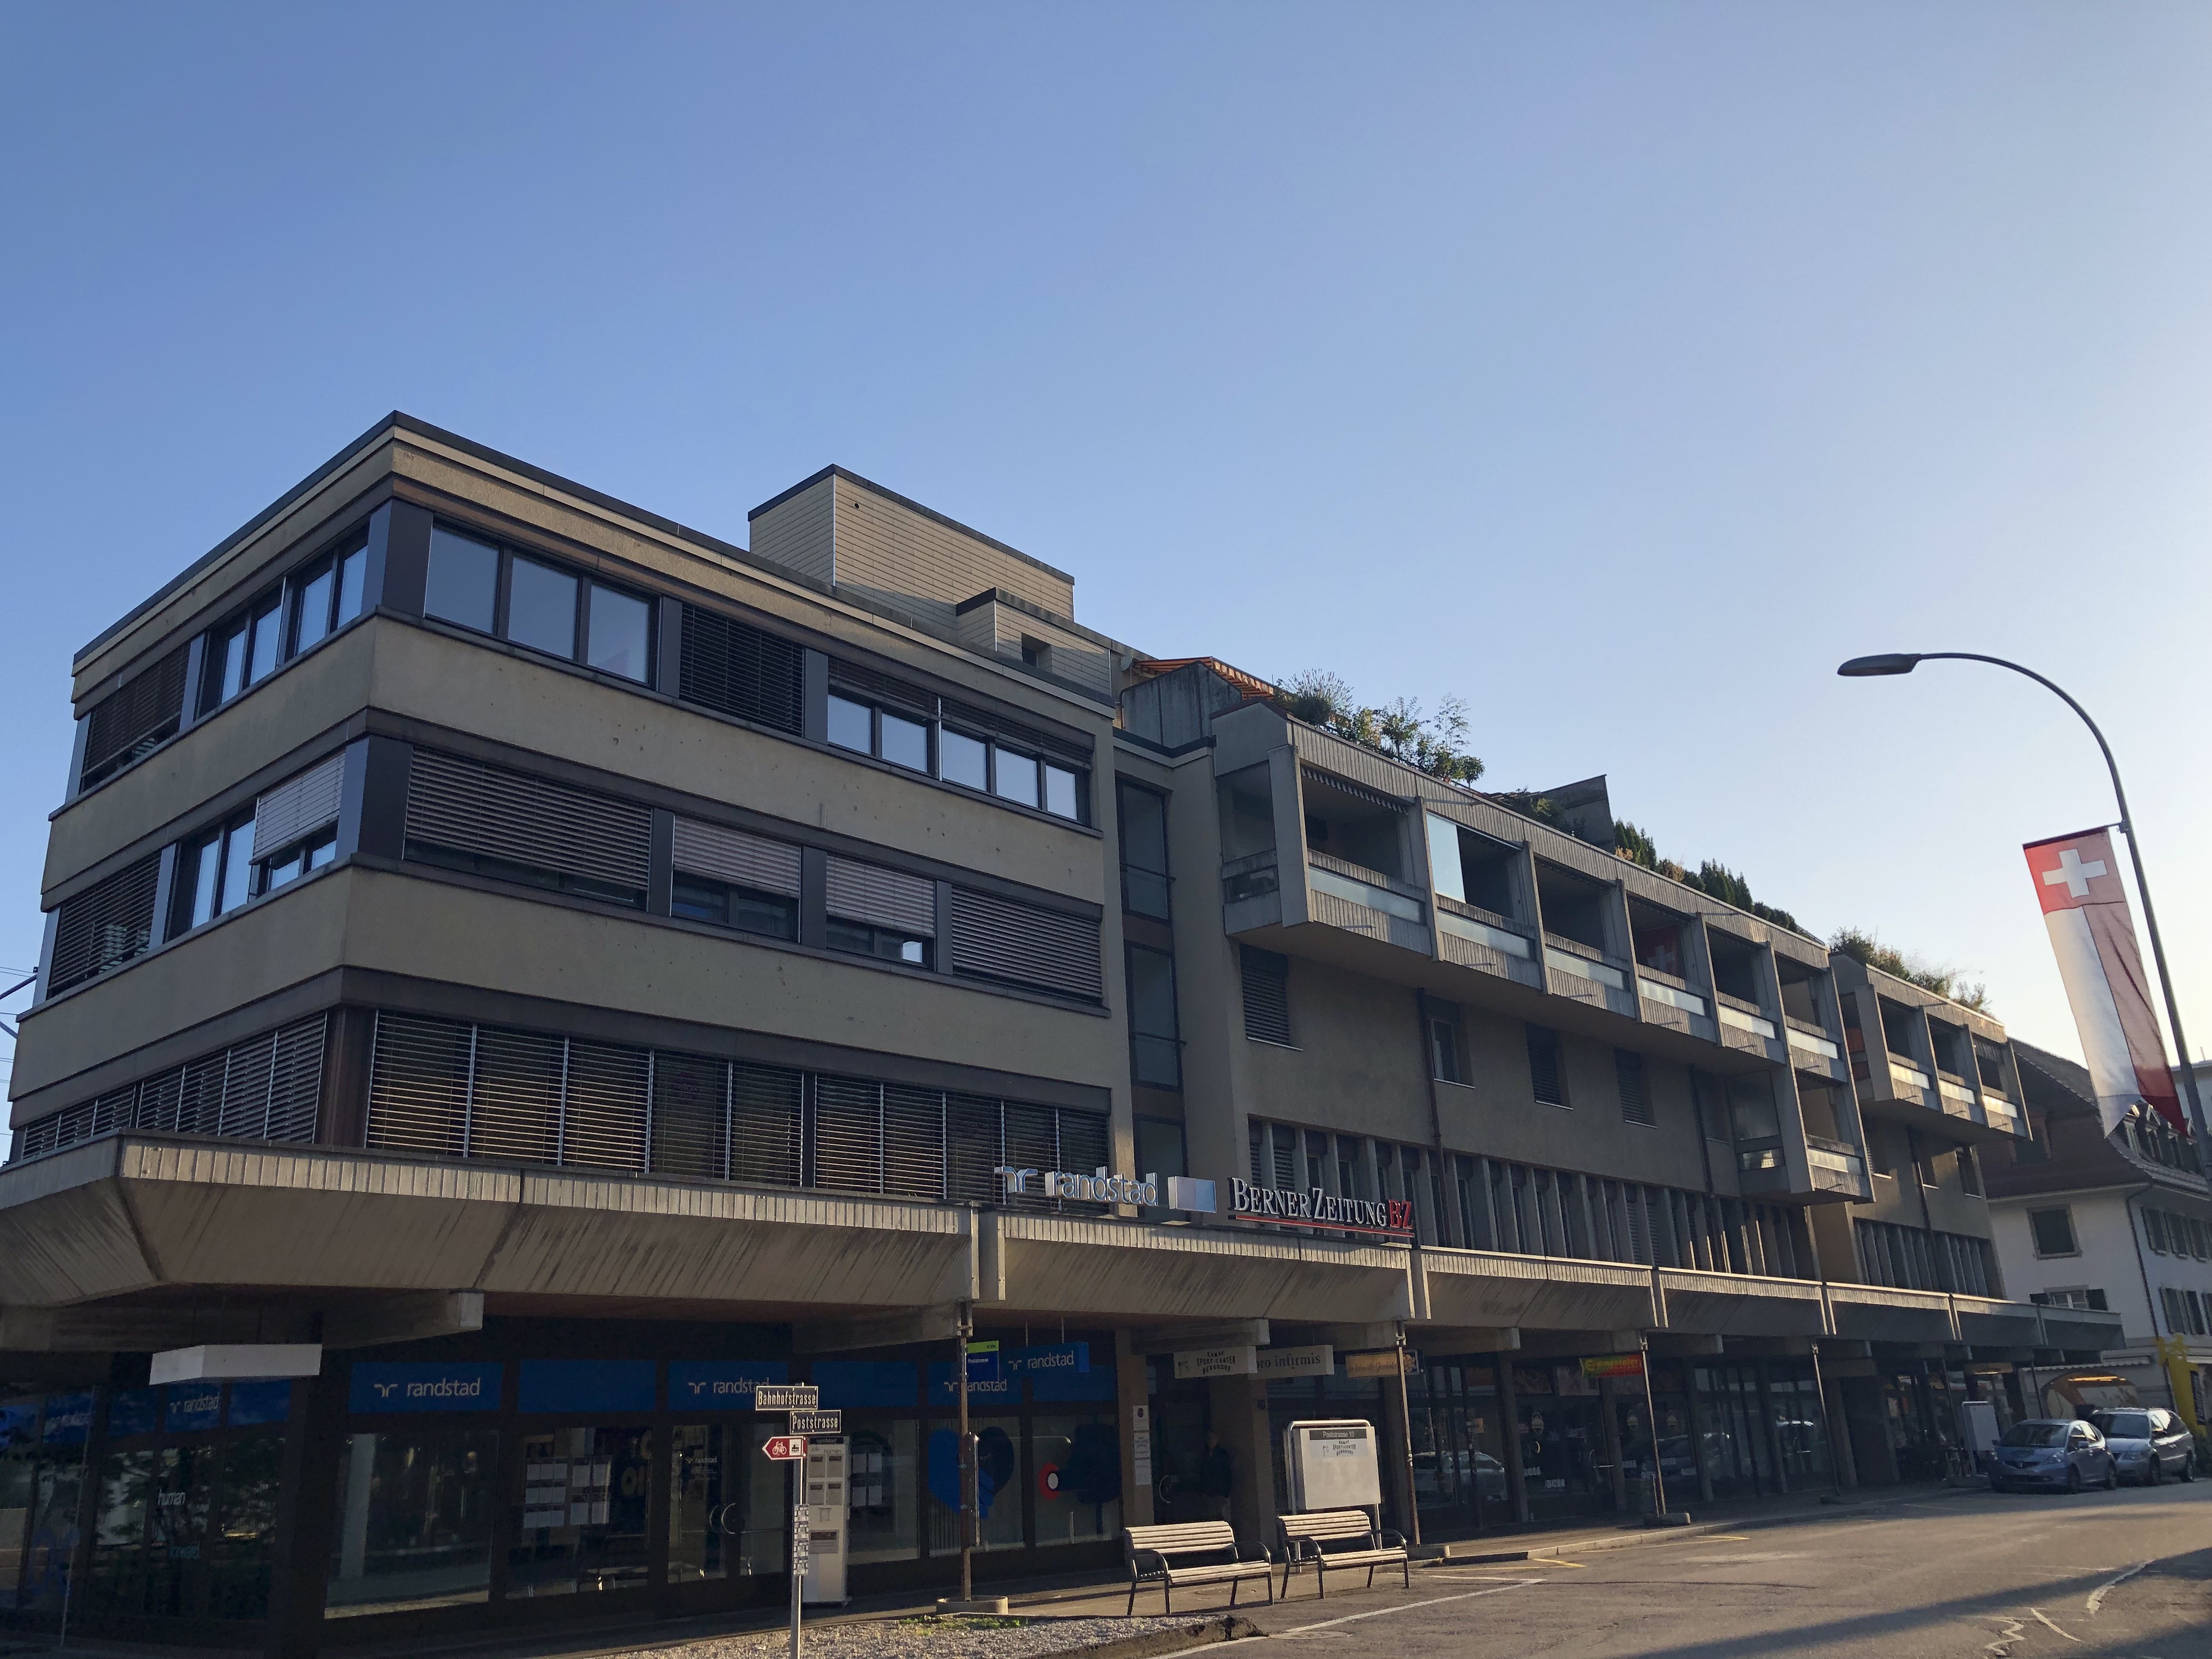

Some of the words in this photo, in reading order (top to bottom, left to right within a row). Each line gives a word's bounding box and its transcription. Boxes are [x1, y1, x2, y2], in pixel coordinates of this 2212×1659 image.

[1045, 1166, 1158, 1206] randstad
[1388, 1199, 1413, 1229] BZ
[1027, 1350, 1074, 1369] randstad
[1274, 1352, 1321, 1369] infirmis
[406, 1377, 481, 1397] randstad
[967, 1378, 1007, 1392] andstad
[184, 1392, 220, 1413] randstad
[758, 1390, 816, 1406] Bahnhofstrasse
[792, 1415, 838, 1430] Poststrasse
[157, 1488, 185, 1506] human
